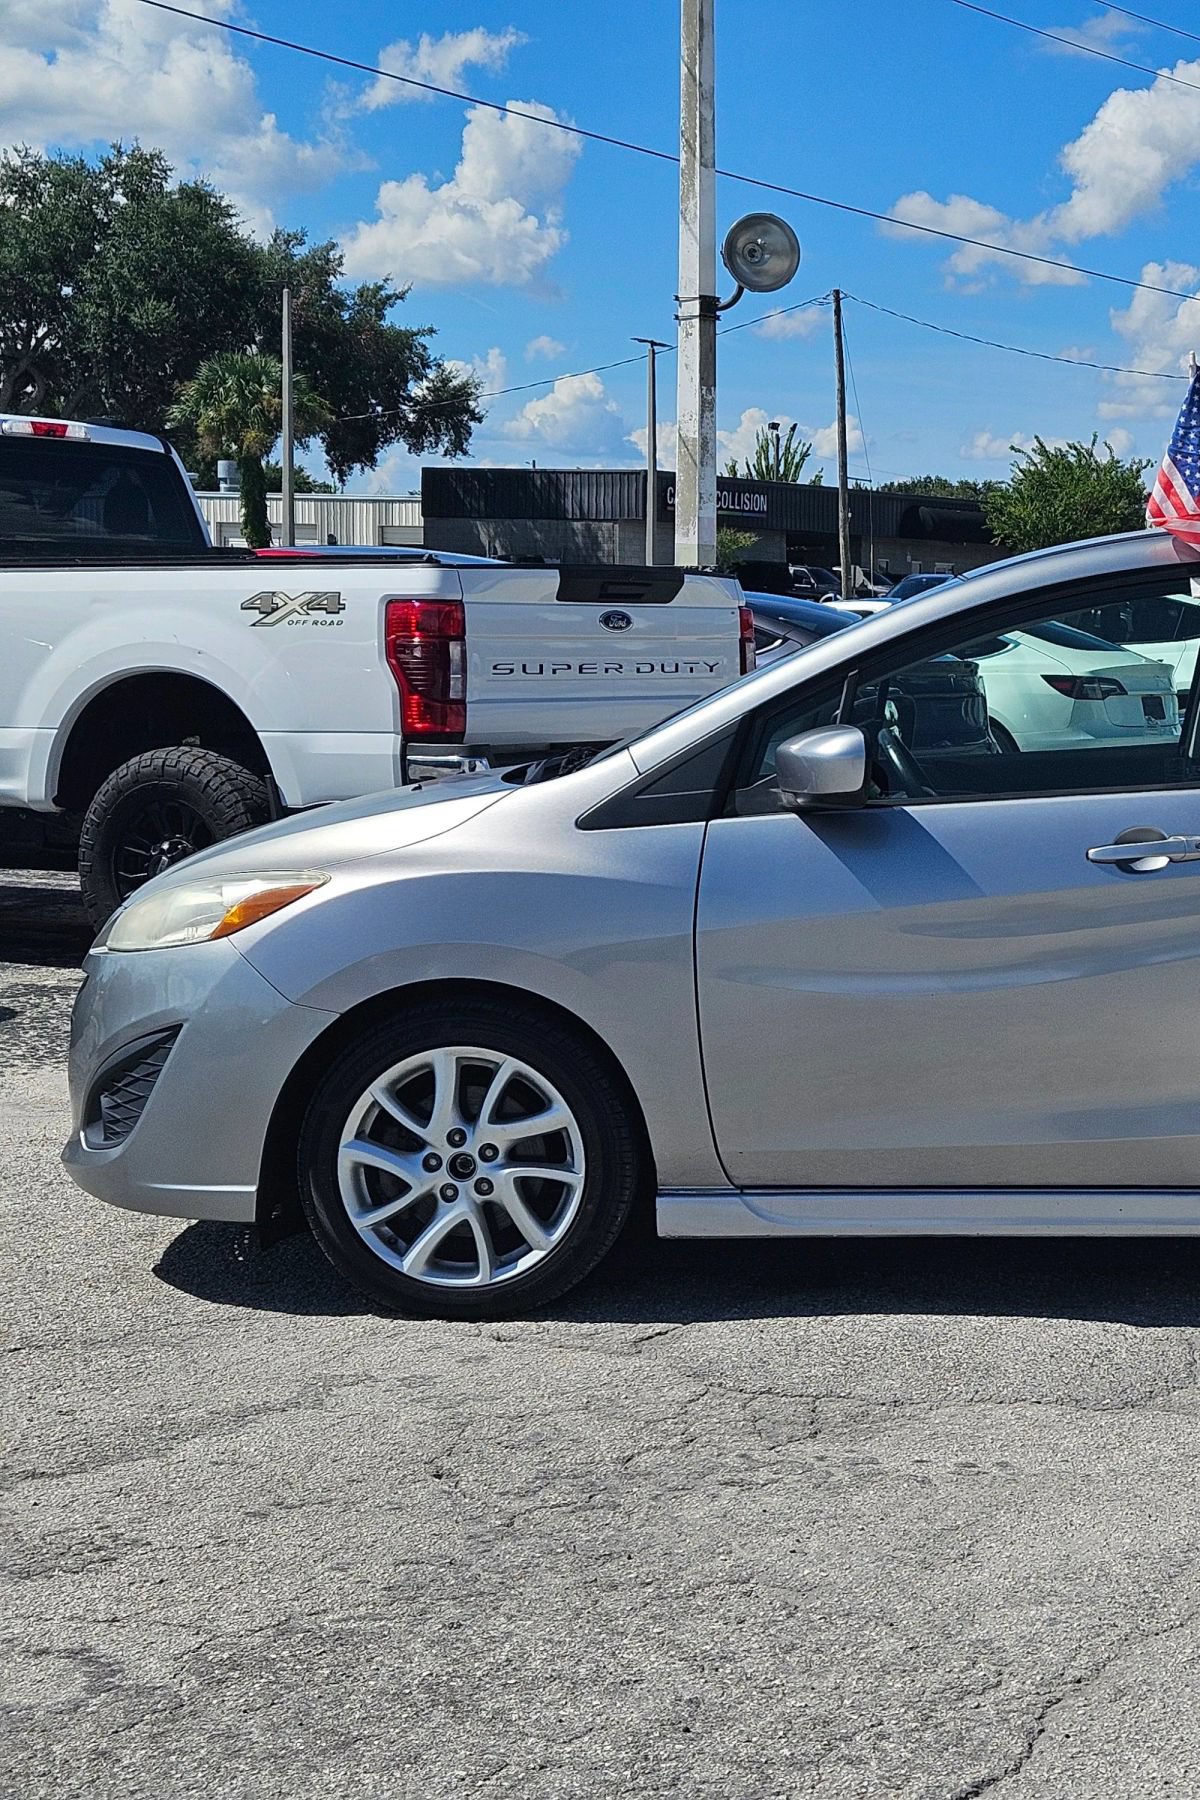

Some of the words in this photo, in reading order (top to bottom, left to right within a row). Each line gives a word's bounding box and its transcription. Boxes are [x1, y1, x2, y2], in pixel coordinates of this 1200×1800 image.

[716, 490, 768, 512] COLLISION
[491, 661, 624, 676] SUPER
[636, 661, 720, 674] DUTY
